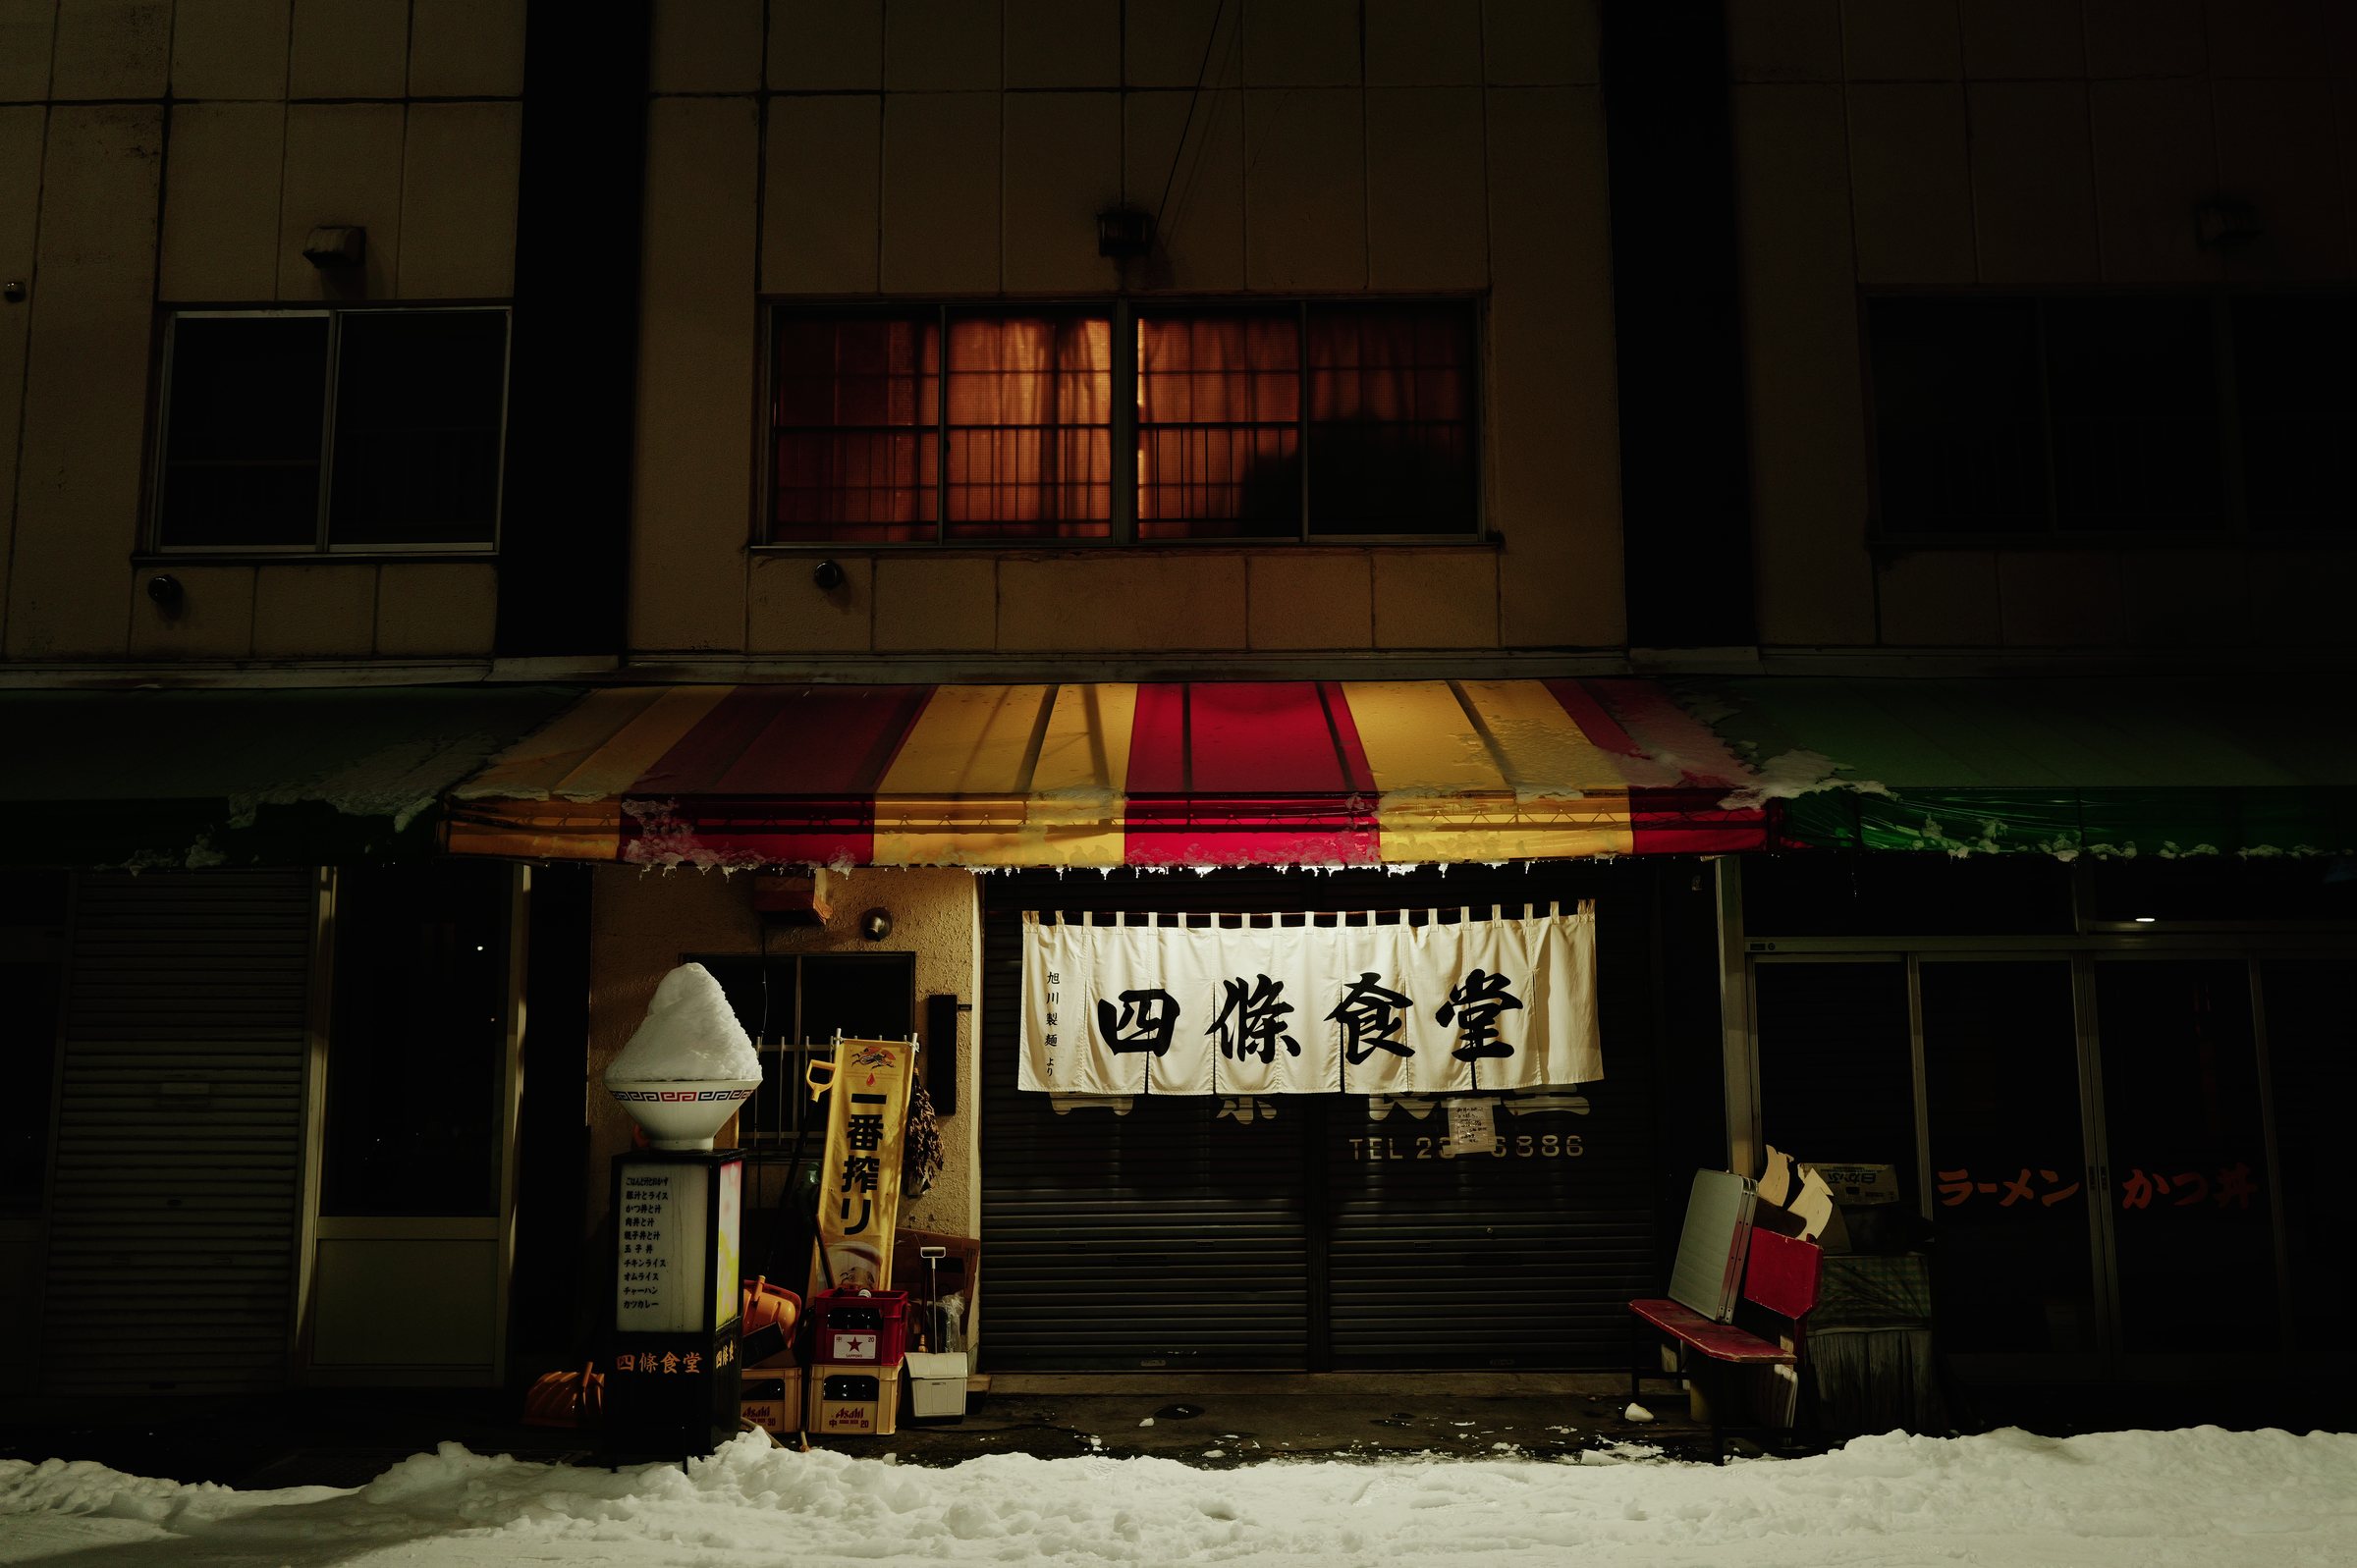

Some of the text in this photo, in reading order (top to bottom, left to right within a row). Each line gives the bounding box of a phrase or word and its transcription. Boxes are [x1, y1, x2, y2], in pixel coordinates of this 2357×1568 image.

[1044, 971, 1061, 1077] 旭川製麺より
[1096, 967, 1524, 1064] 四條食堂
[1347, 1137, 1403, 1161] TEL
[840, 1092, 888, 1236] 一番搾り
[1935, 1169, 2081, 1209] ラーメン
[2120, 1162, 2259, 1210] かつ丼
[624, 1259, 667, 1268] チキンライス
[624, 1272, 659, 1281] オムライス
[624, 1286, 658, 1295] チャーハン
[624, 1300, 659, 1309] カツカレー
[616, 1351, 703, 1374] 四條食堂
[835, 1407, 864, 1419] Asahi
[860, 1420, 869, 1429] 20
